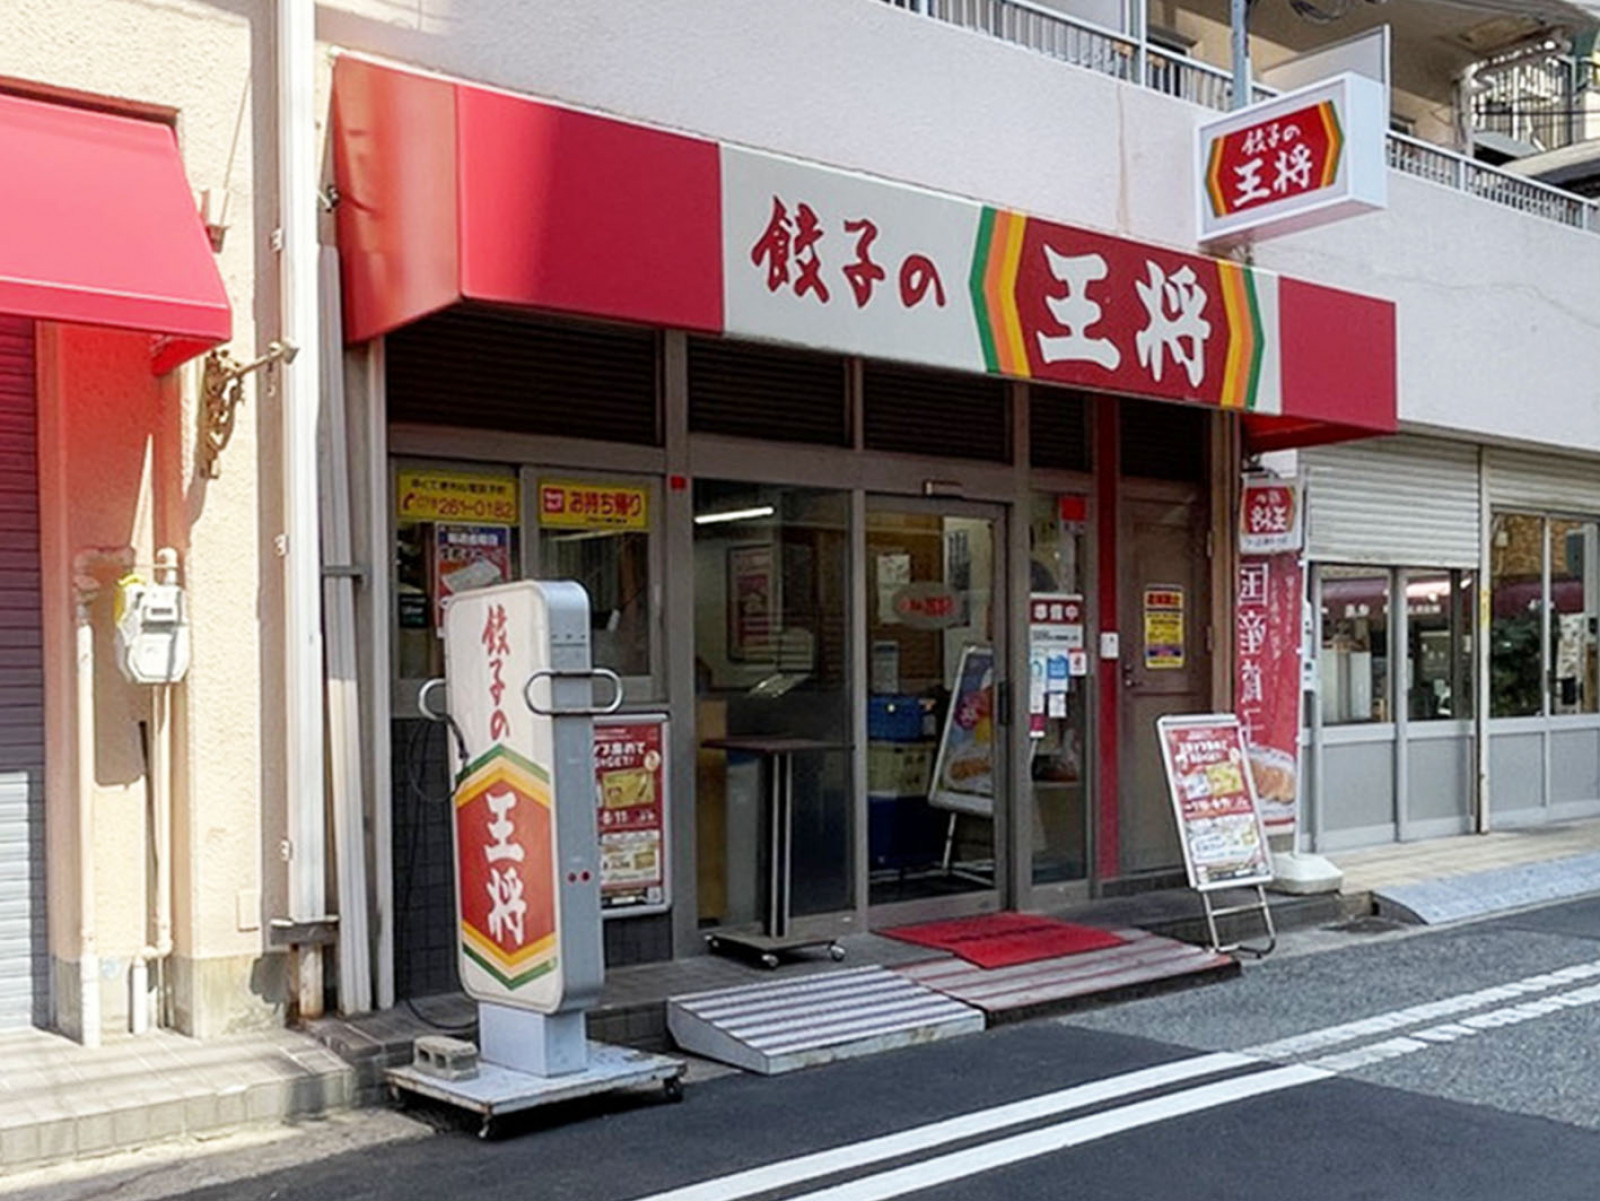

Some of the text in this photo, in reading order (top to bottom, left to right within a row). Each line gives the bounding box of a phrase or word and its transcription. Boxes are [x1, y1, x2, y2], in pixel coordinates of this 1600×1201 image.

[1232, 143, 1313, 208] 王将
[1241, 123, 1300, 156] 餃子の
[751, 195, 946, 309] 餃子の
[1035, 242, 1213, 388] 王将
[568, 490, 642, 518] お持ち帰り
[481, 604, 513, 742] 餃子の
[484, 791, 527, 949] 王将
